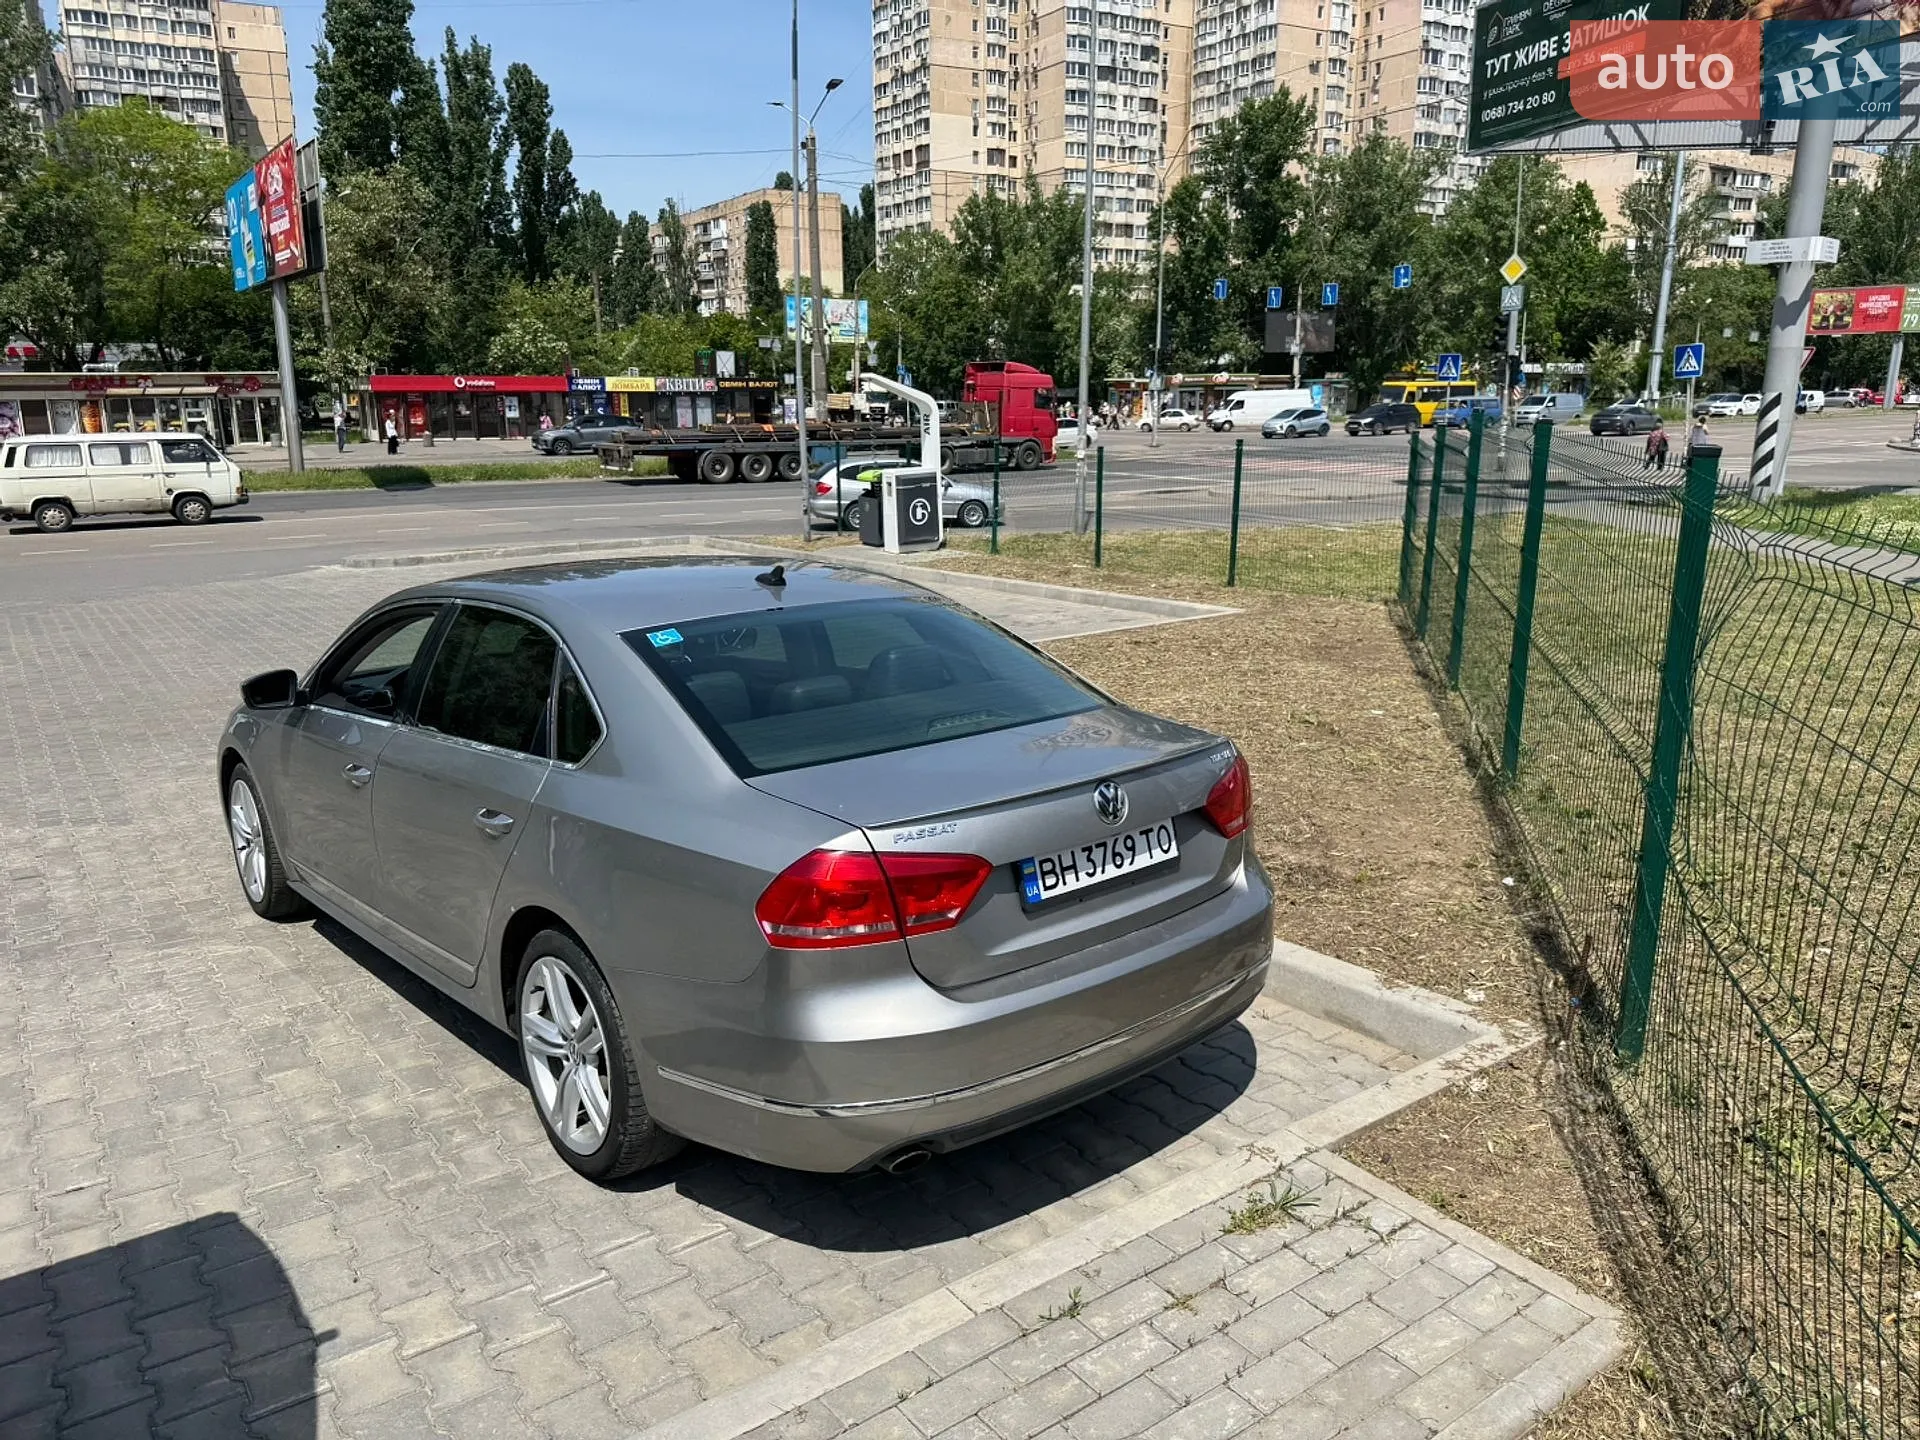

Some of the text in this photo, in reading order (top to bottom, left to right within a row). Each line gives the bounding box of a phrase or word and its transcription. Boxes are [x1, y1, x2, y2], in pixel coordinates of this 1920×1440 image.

[1485, 3, 1650, 79] ТУТ ЖИВЕ ЗАТИШОК
[1481, 90, 1556, 123] (068) 734 20 80
[665, 377, 705, 391] КВІТИ
[923, 414, 931, 435] AIR
[892, 822, 958, 845] PASSAT
[1038, 823, 1173, 892] BH 3769 TO
[1026, 886, 1040, 897] UA
